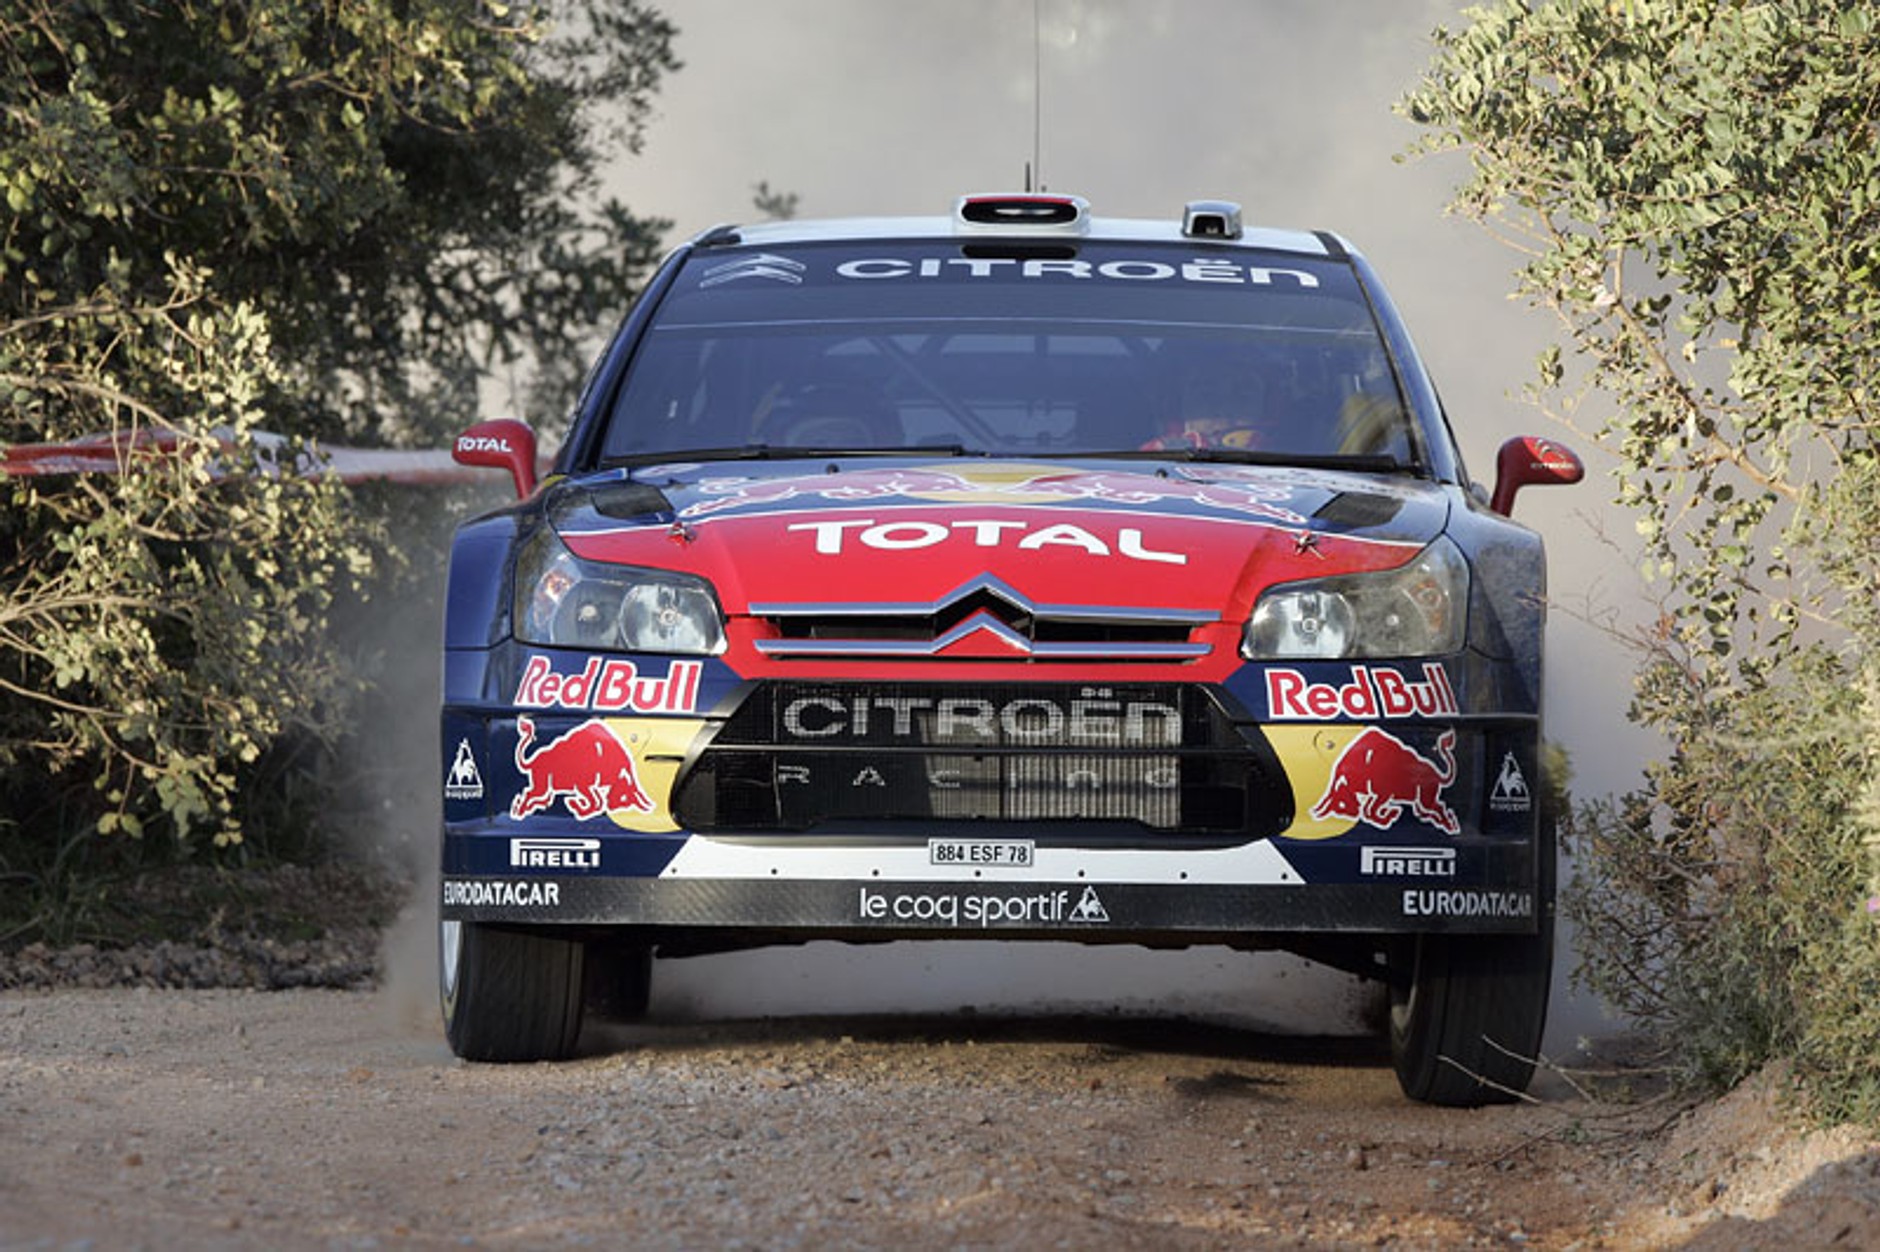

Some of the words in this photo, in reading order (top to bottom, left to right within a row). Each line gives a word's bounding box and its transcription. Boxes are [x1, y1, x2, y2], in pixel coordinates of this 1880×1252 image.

[458, 436, 512, 453] TOTAL
[788, 519, 1187, 565] TOTAL
[514, 655, 599, 708] Red
[593, 658, 703, 714] Bull
[1264, 665, 1379, 721] Red
[1373, 662, 1460, 719] Bull
[510, 838, 601, 867] PIRELLI
[935, 844, 965, 863] 884
[969, 844, 1003, 863] ESF
[1008, 845, 1028, 864] 78
[1360, 846, 1456, 876] PIRELLI
[443, 881, 560, 906] EURODATACAR
[859, 887, 889, 917] le
[892, 892, 959, 926] coq
[963, 889, 1069, 927] sportif
[1402, 890, 1532, 916] EURODATACAR
